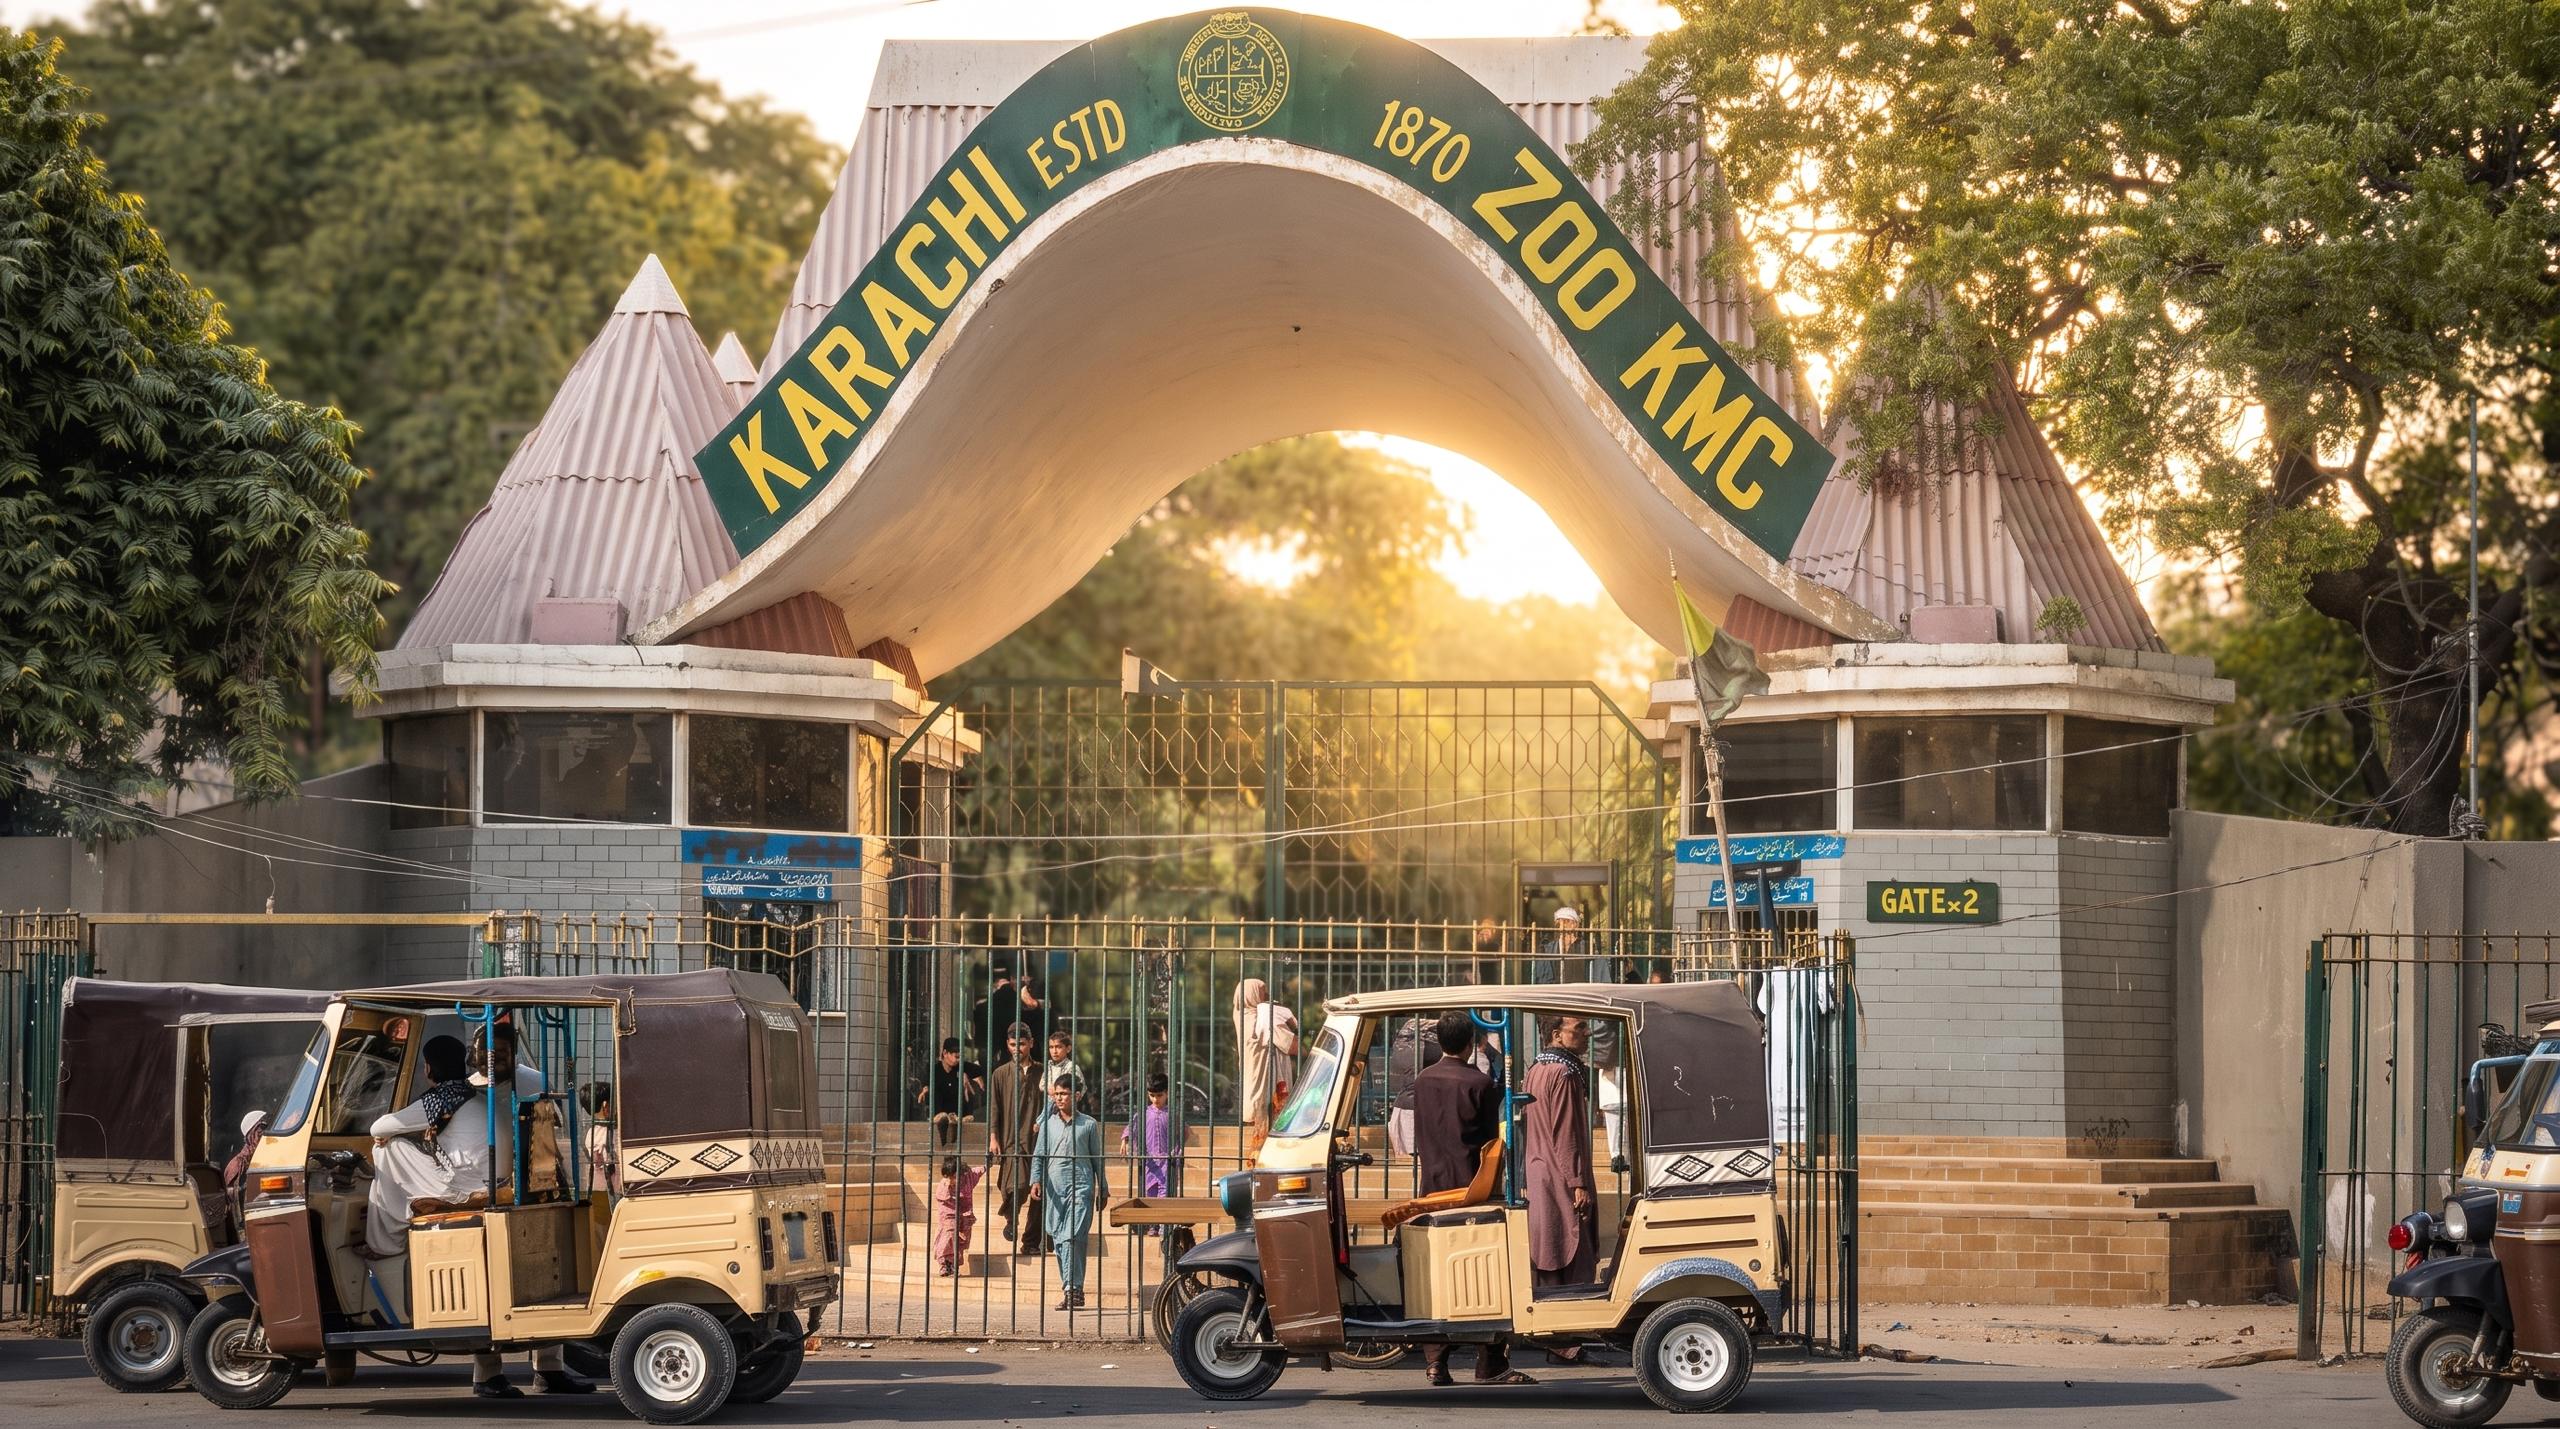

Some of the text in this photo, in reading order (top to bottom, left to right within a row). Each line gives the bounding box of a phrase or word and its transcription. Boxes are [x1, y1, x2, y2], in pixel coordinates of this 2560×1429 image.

[1027, 99, 1470, 190] ESTD 1870
[730, 145, 1794, 514] KARACHI ZOO KMC
